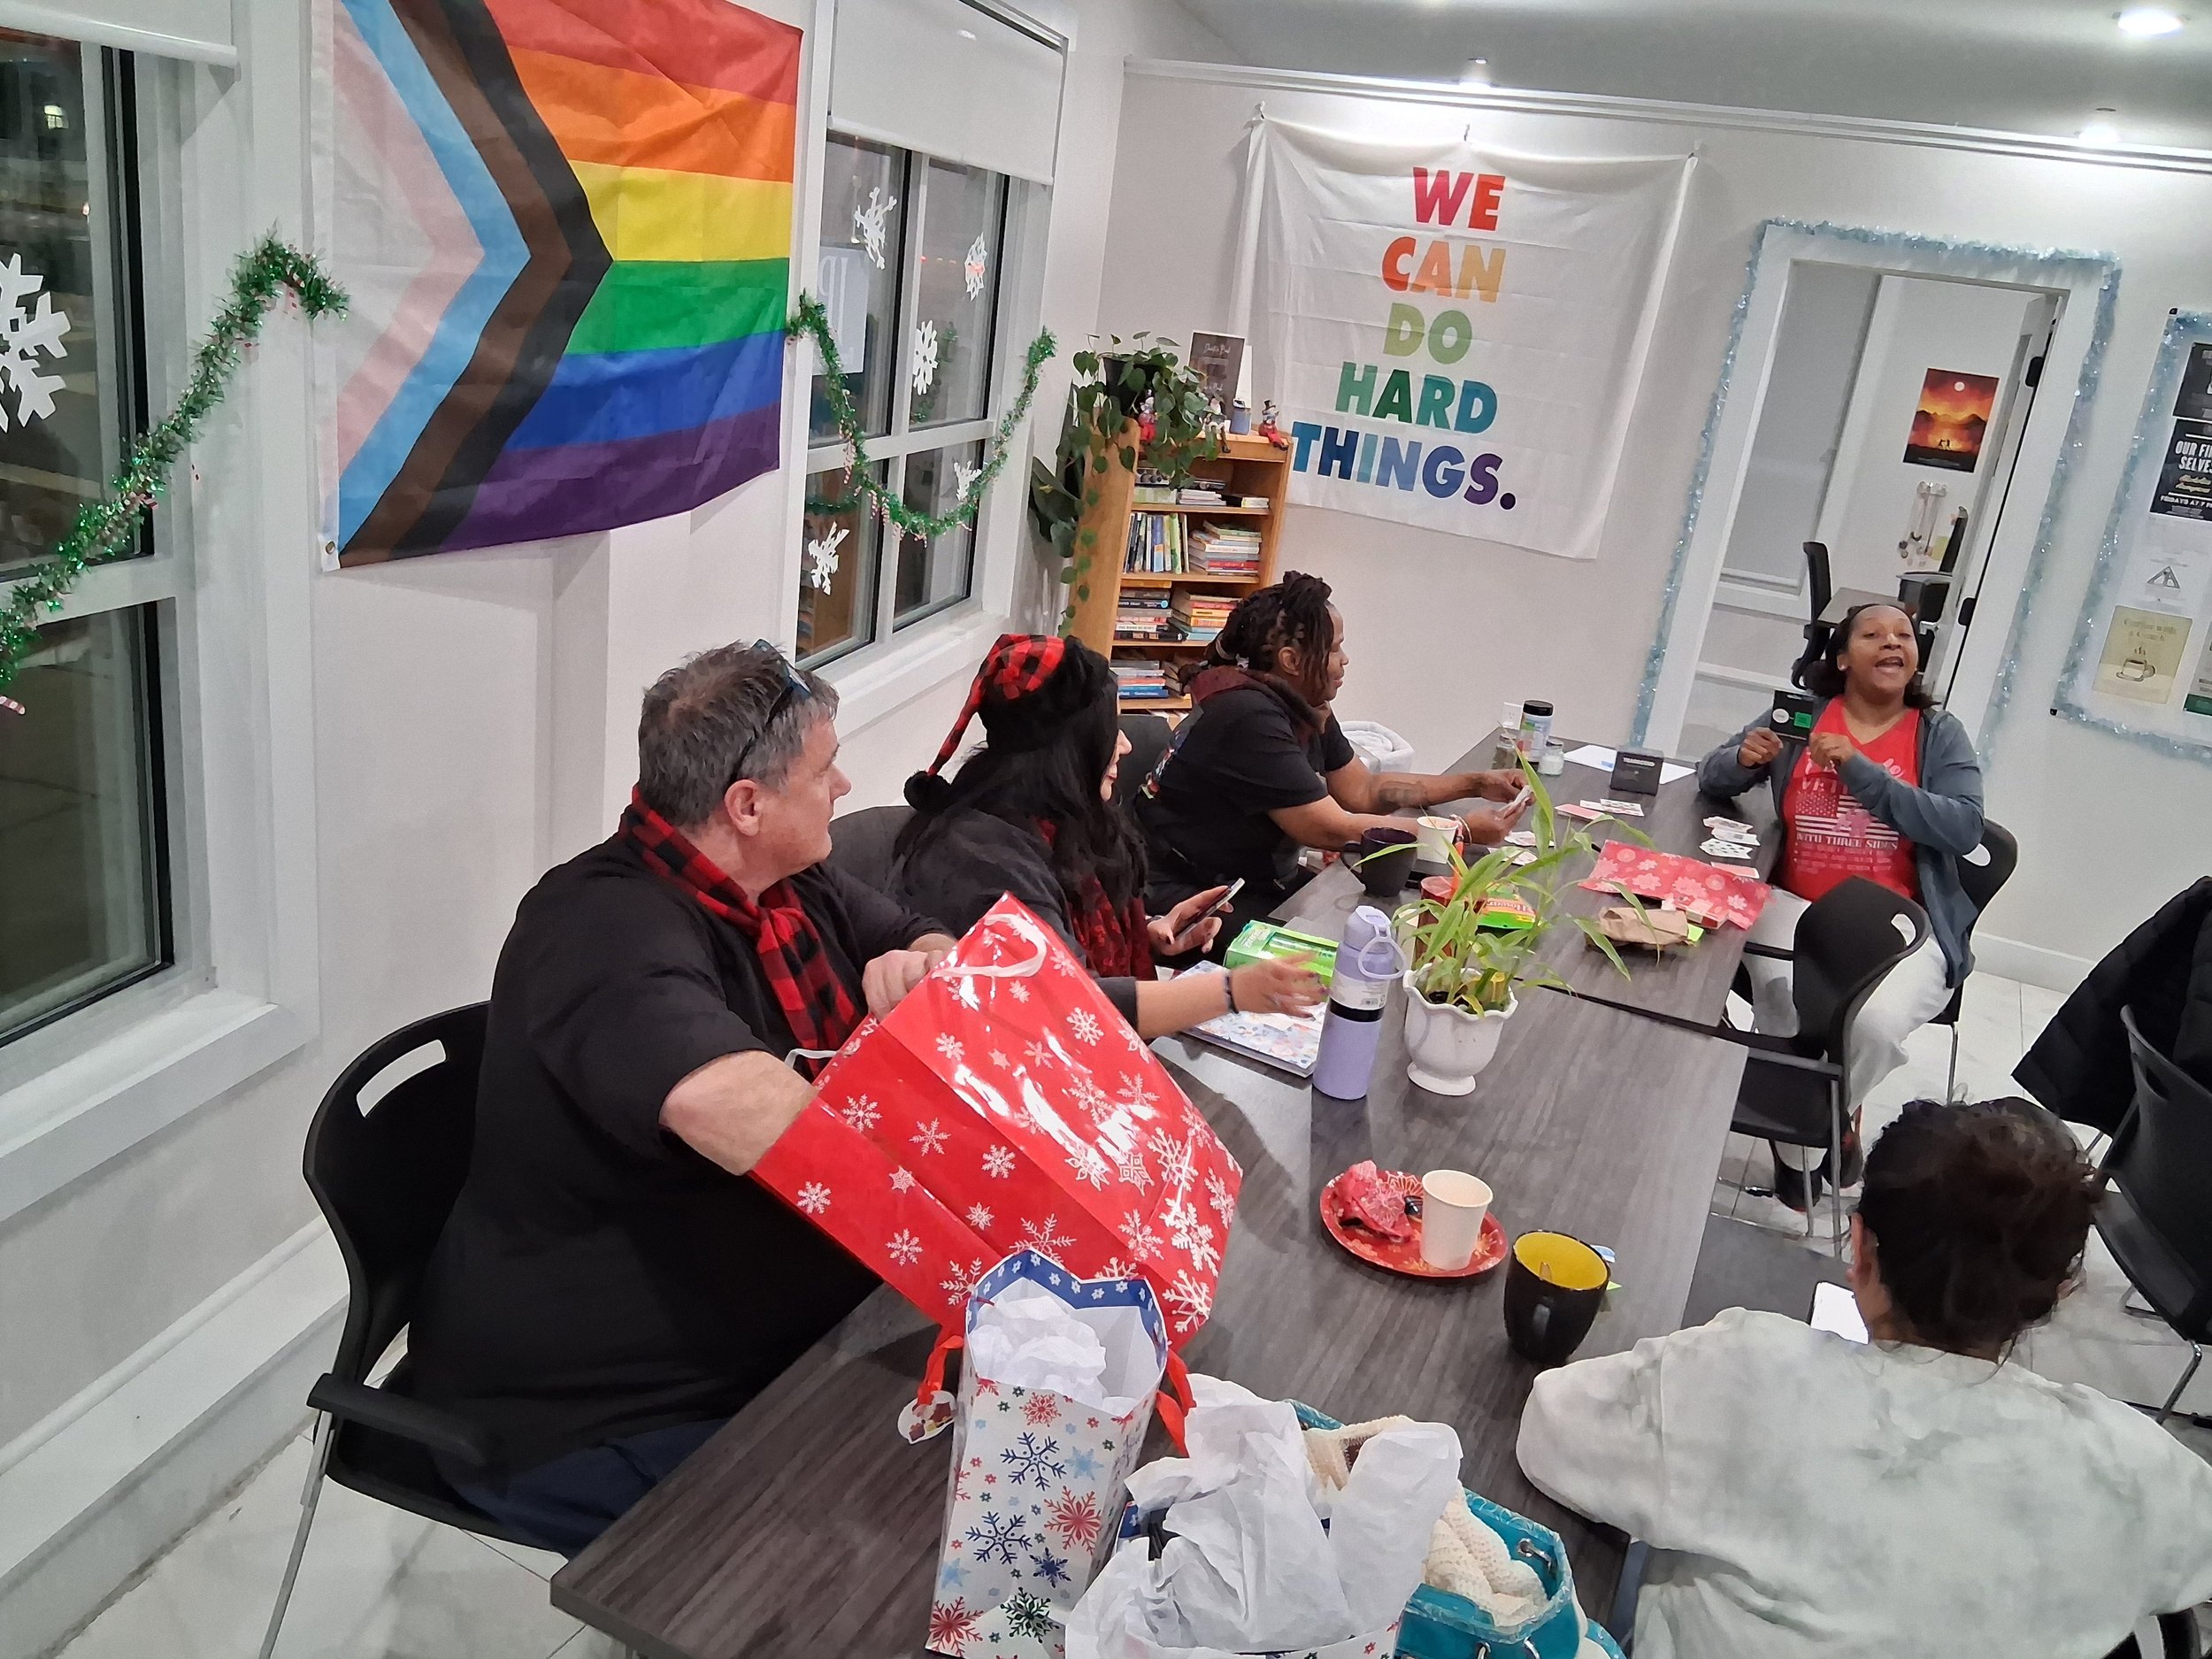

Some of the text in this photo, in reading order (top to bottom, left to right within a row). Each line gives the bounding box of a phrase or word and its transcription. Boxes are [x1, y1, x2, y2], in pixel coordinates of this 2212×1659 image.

[1413, 166, 1506, 231] WE
[1381, 236, 1506, 303] CAN
[1382, 303, 1473, 365] DO
[1334, 361, 1498, 434] HARD
[1291, 421, 1517, 511] THINGS.
[2175, 441, 2197, 456] OUR
